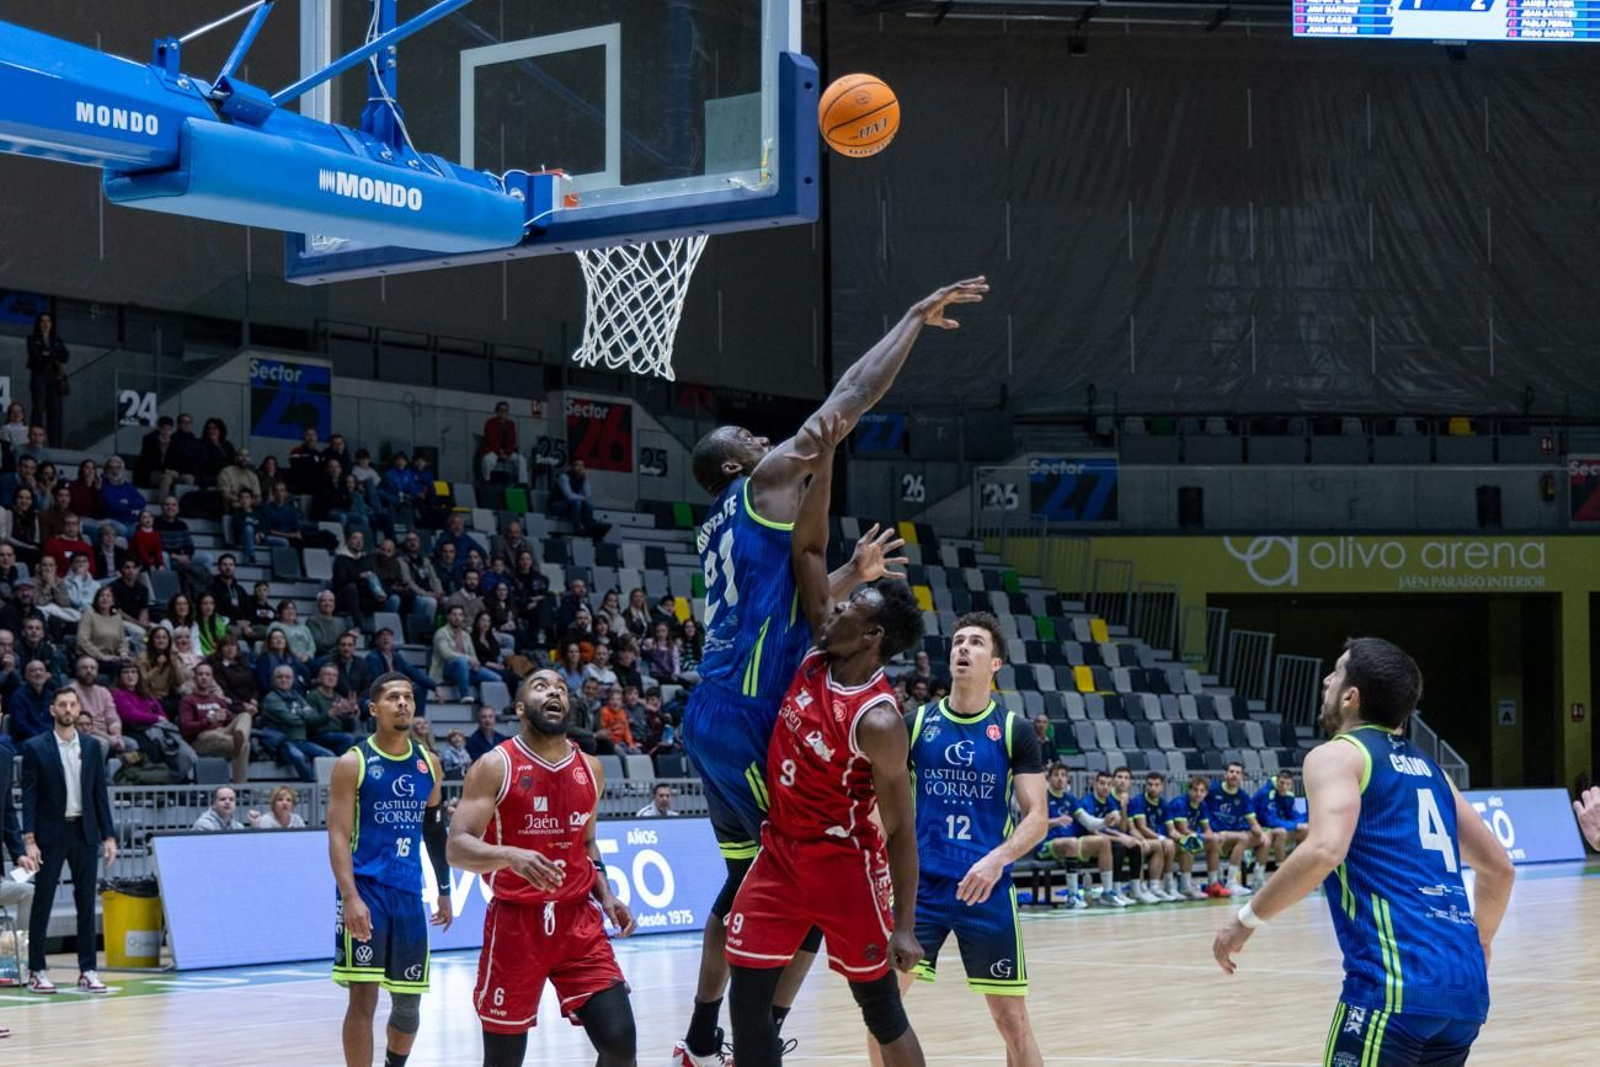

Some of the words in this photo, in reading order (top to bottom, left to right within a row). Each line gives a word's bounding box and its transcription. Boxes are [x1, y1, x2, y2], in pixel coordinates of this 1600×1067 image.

[76, 101, 159, 136] MONDO
[336, 171, 423, 211] MONDO
[250, 359, 302, 382] Sector
[118, 389, 158, 427] 24
[564, 399, 610, 421] Sector
[1029, 459, 1086, 475] Sector
[902, 473, 925, 502] 26
[982, 482, 1019, 510] 26
[1309, 536, 1407, 569] olivo
[1420, 541, 1546, 569] arena
[1398, 573, 1429, 591] JAÉN
[1431, 574, 1485, 589] PARAÍSO
[1487, 575, 1546, 589] INTERIOR
[780, 758, 797, 786] 9
[924, 768, 977, 782] CASTILLO
[981, 772, 997, 784] DE
[925, 781, 995, 800] GORRAIZ
[374, 800, 418, 811] CASTILLO
[524, 814, 559, 829] Jaén
[945, 815, 972, 841] 12
[1416, 788, 1458, 873] 4
[627, 828, 658, 845] AÑOS
[396, 838, 411, 857] 16
[637, 912, 667, 927] desde
[667, 909, 694, 925] 1975
[731, 913, 744, 934] 9
[493, 987, 506, 1006] 6
